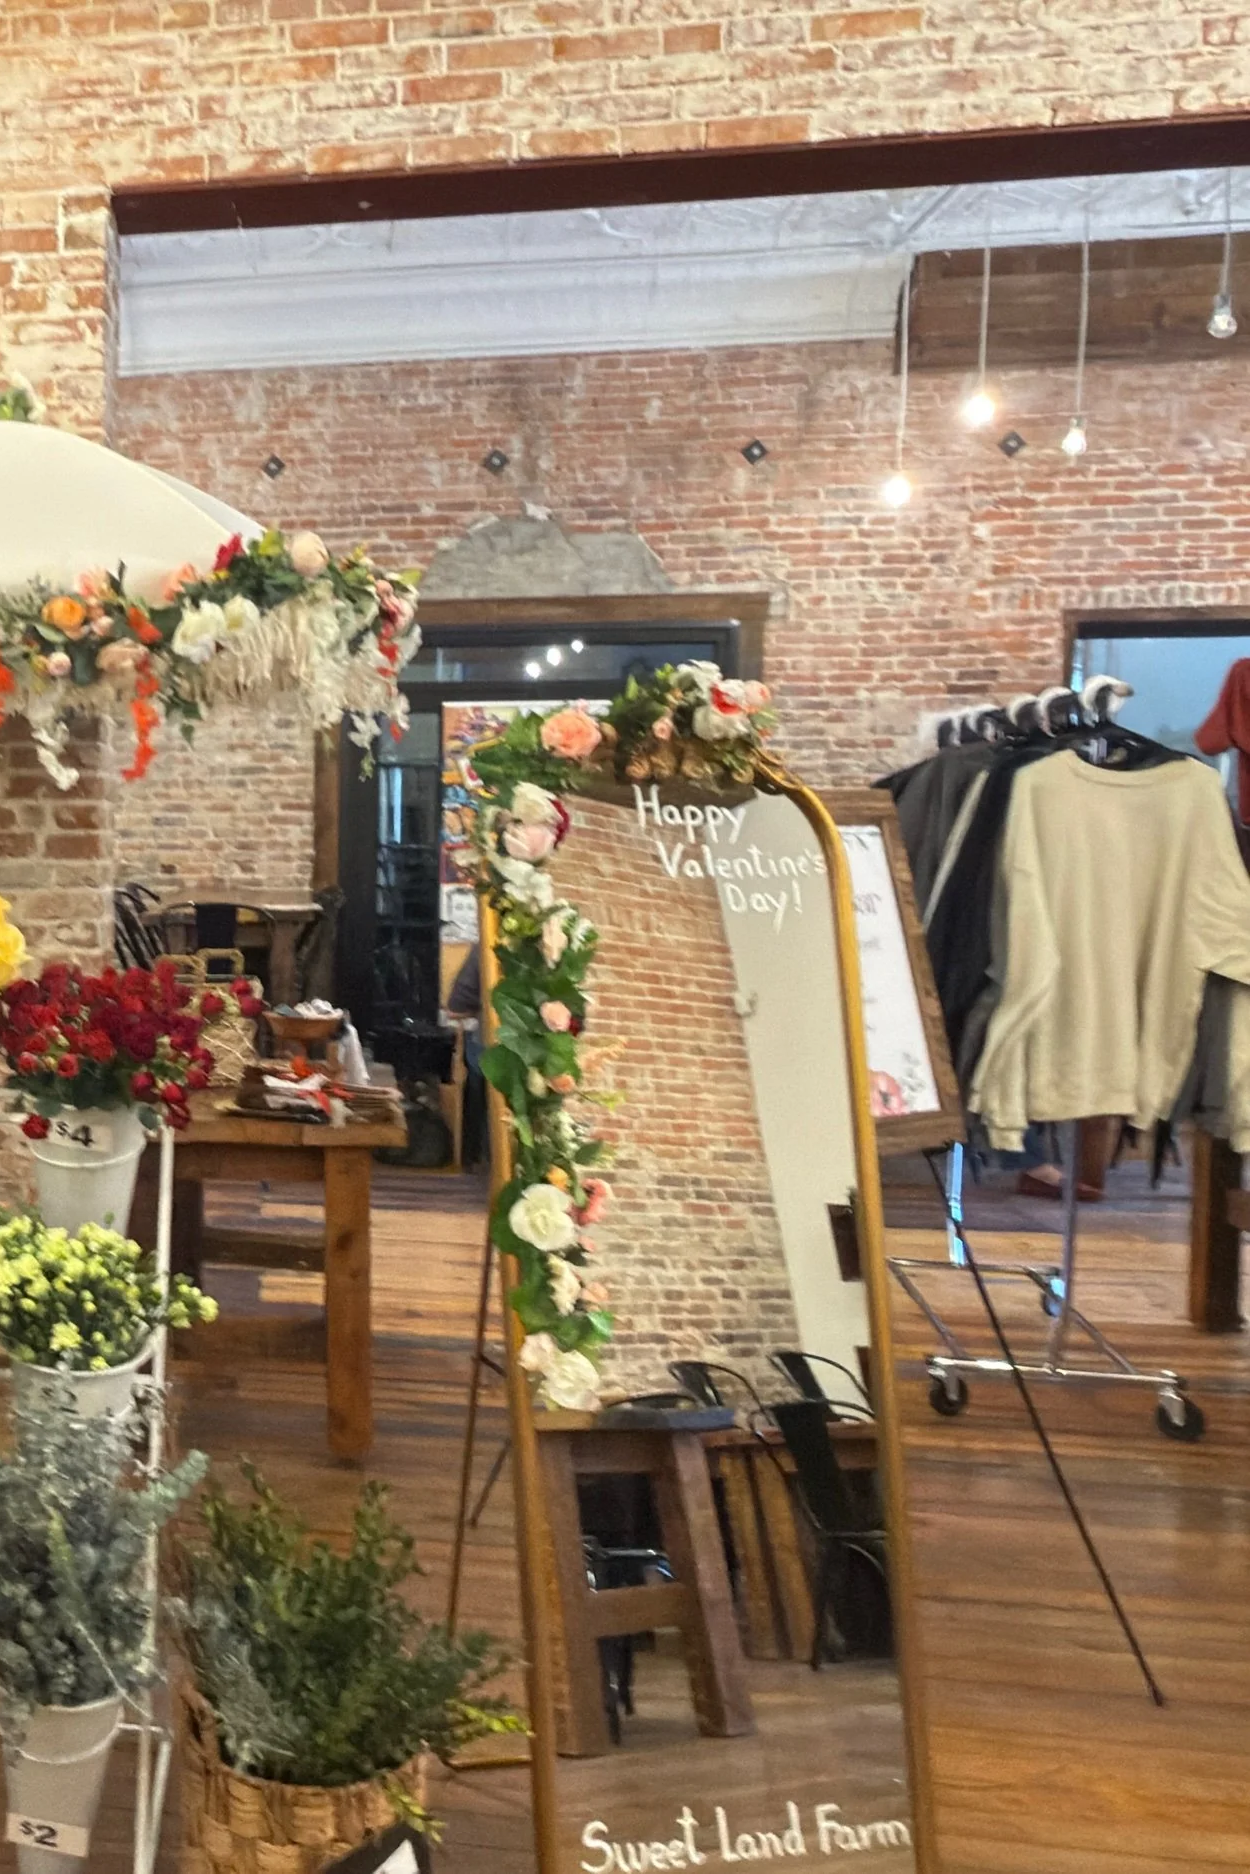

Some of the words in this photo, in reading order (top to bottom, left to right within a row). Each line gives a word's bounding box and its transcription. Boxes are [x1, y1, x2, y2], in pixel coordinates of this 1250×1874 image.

[632, 784, 746, 844] Happy
[654, 840, 826, 880] Valentine's
[723, 879, 803, 934] Day!
[56, 1120, 95, 1147] $4
[18, 1820, 58, 1848] $2
[580, 1805, 708, 1874] Sweet
[714, 1800, 807, 1863] Land
[815, 1803, 913, 1856] Farm
